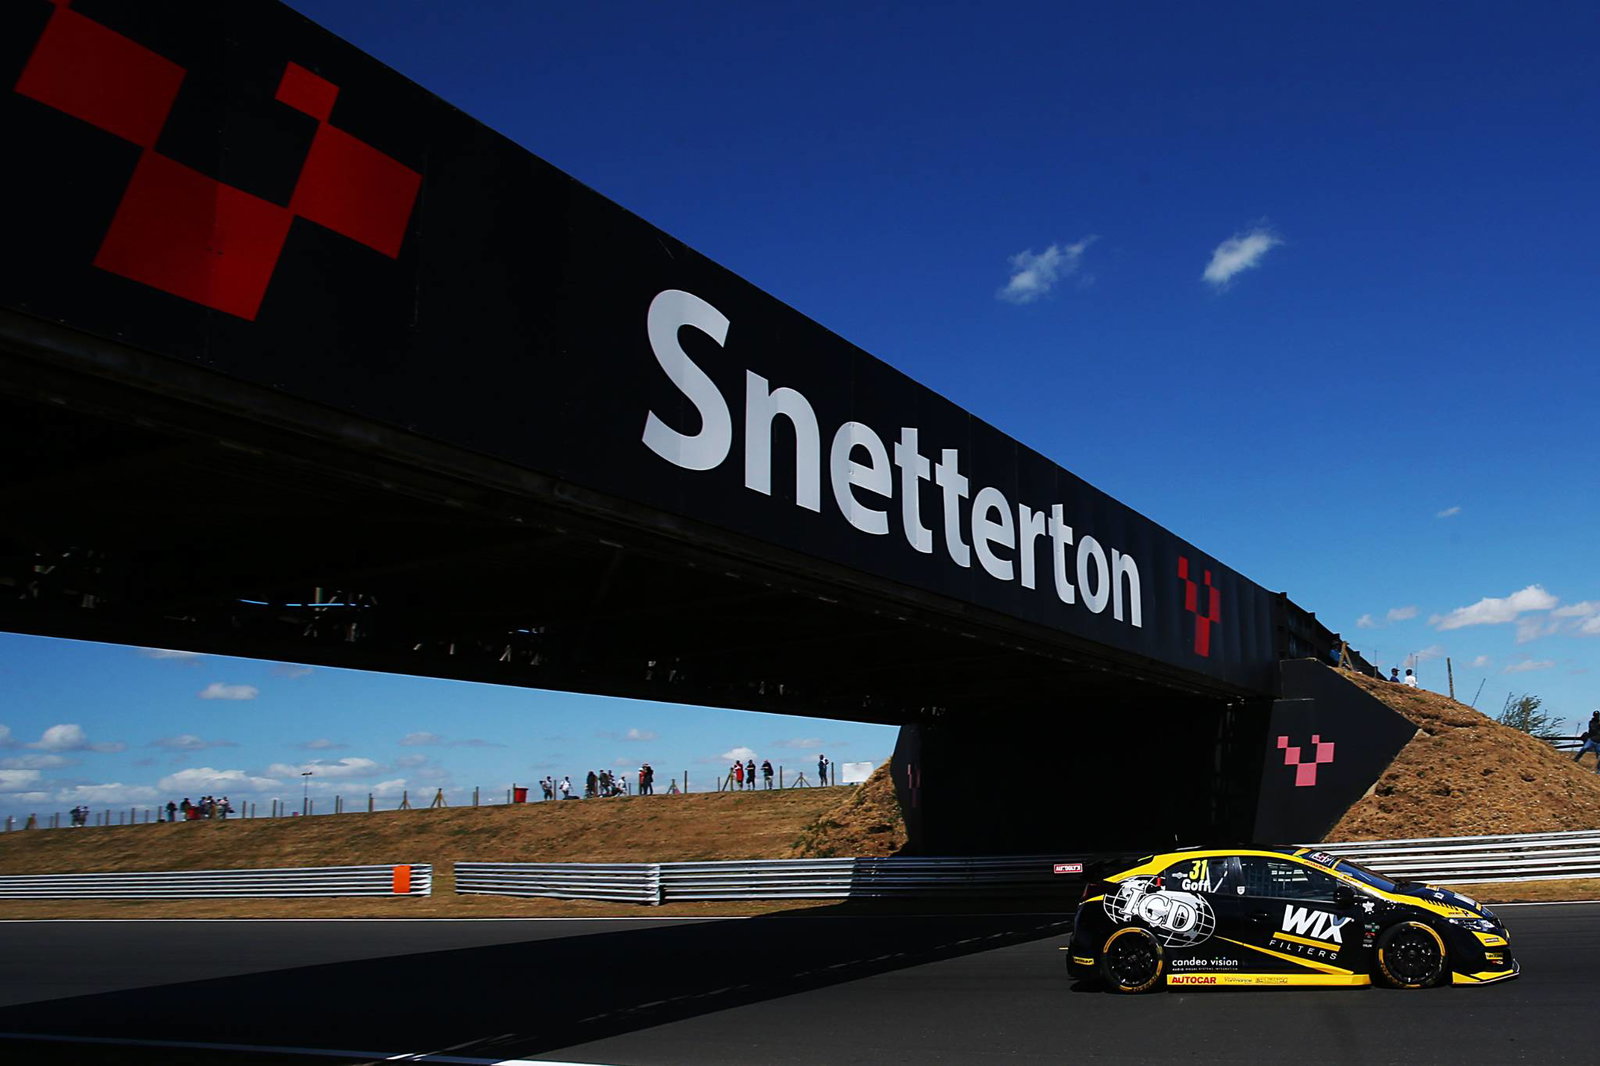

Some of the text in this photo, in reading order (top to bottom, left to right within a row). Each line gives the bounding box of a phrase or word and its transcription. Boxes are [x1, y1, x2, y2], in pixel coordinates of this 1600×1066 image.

[642, 289, 1142, 628] Snetterton
[1189, 859, 1208, 880] 31
[1182, 879, 1210, 892] Goff
[1119, 887, 1199, 933] ICD
[1281, 904, 1352, 943] WIX
[1268, 939, 1338, 960] FILTERS
[1172, 956, 1238, 966] candeo vision
[1171, 976, 1217, 984] AUTOCAR
